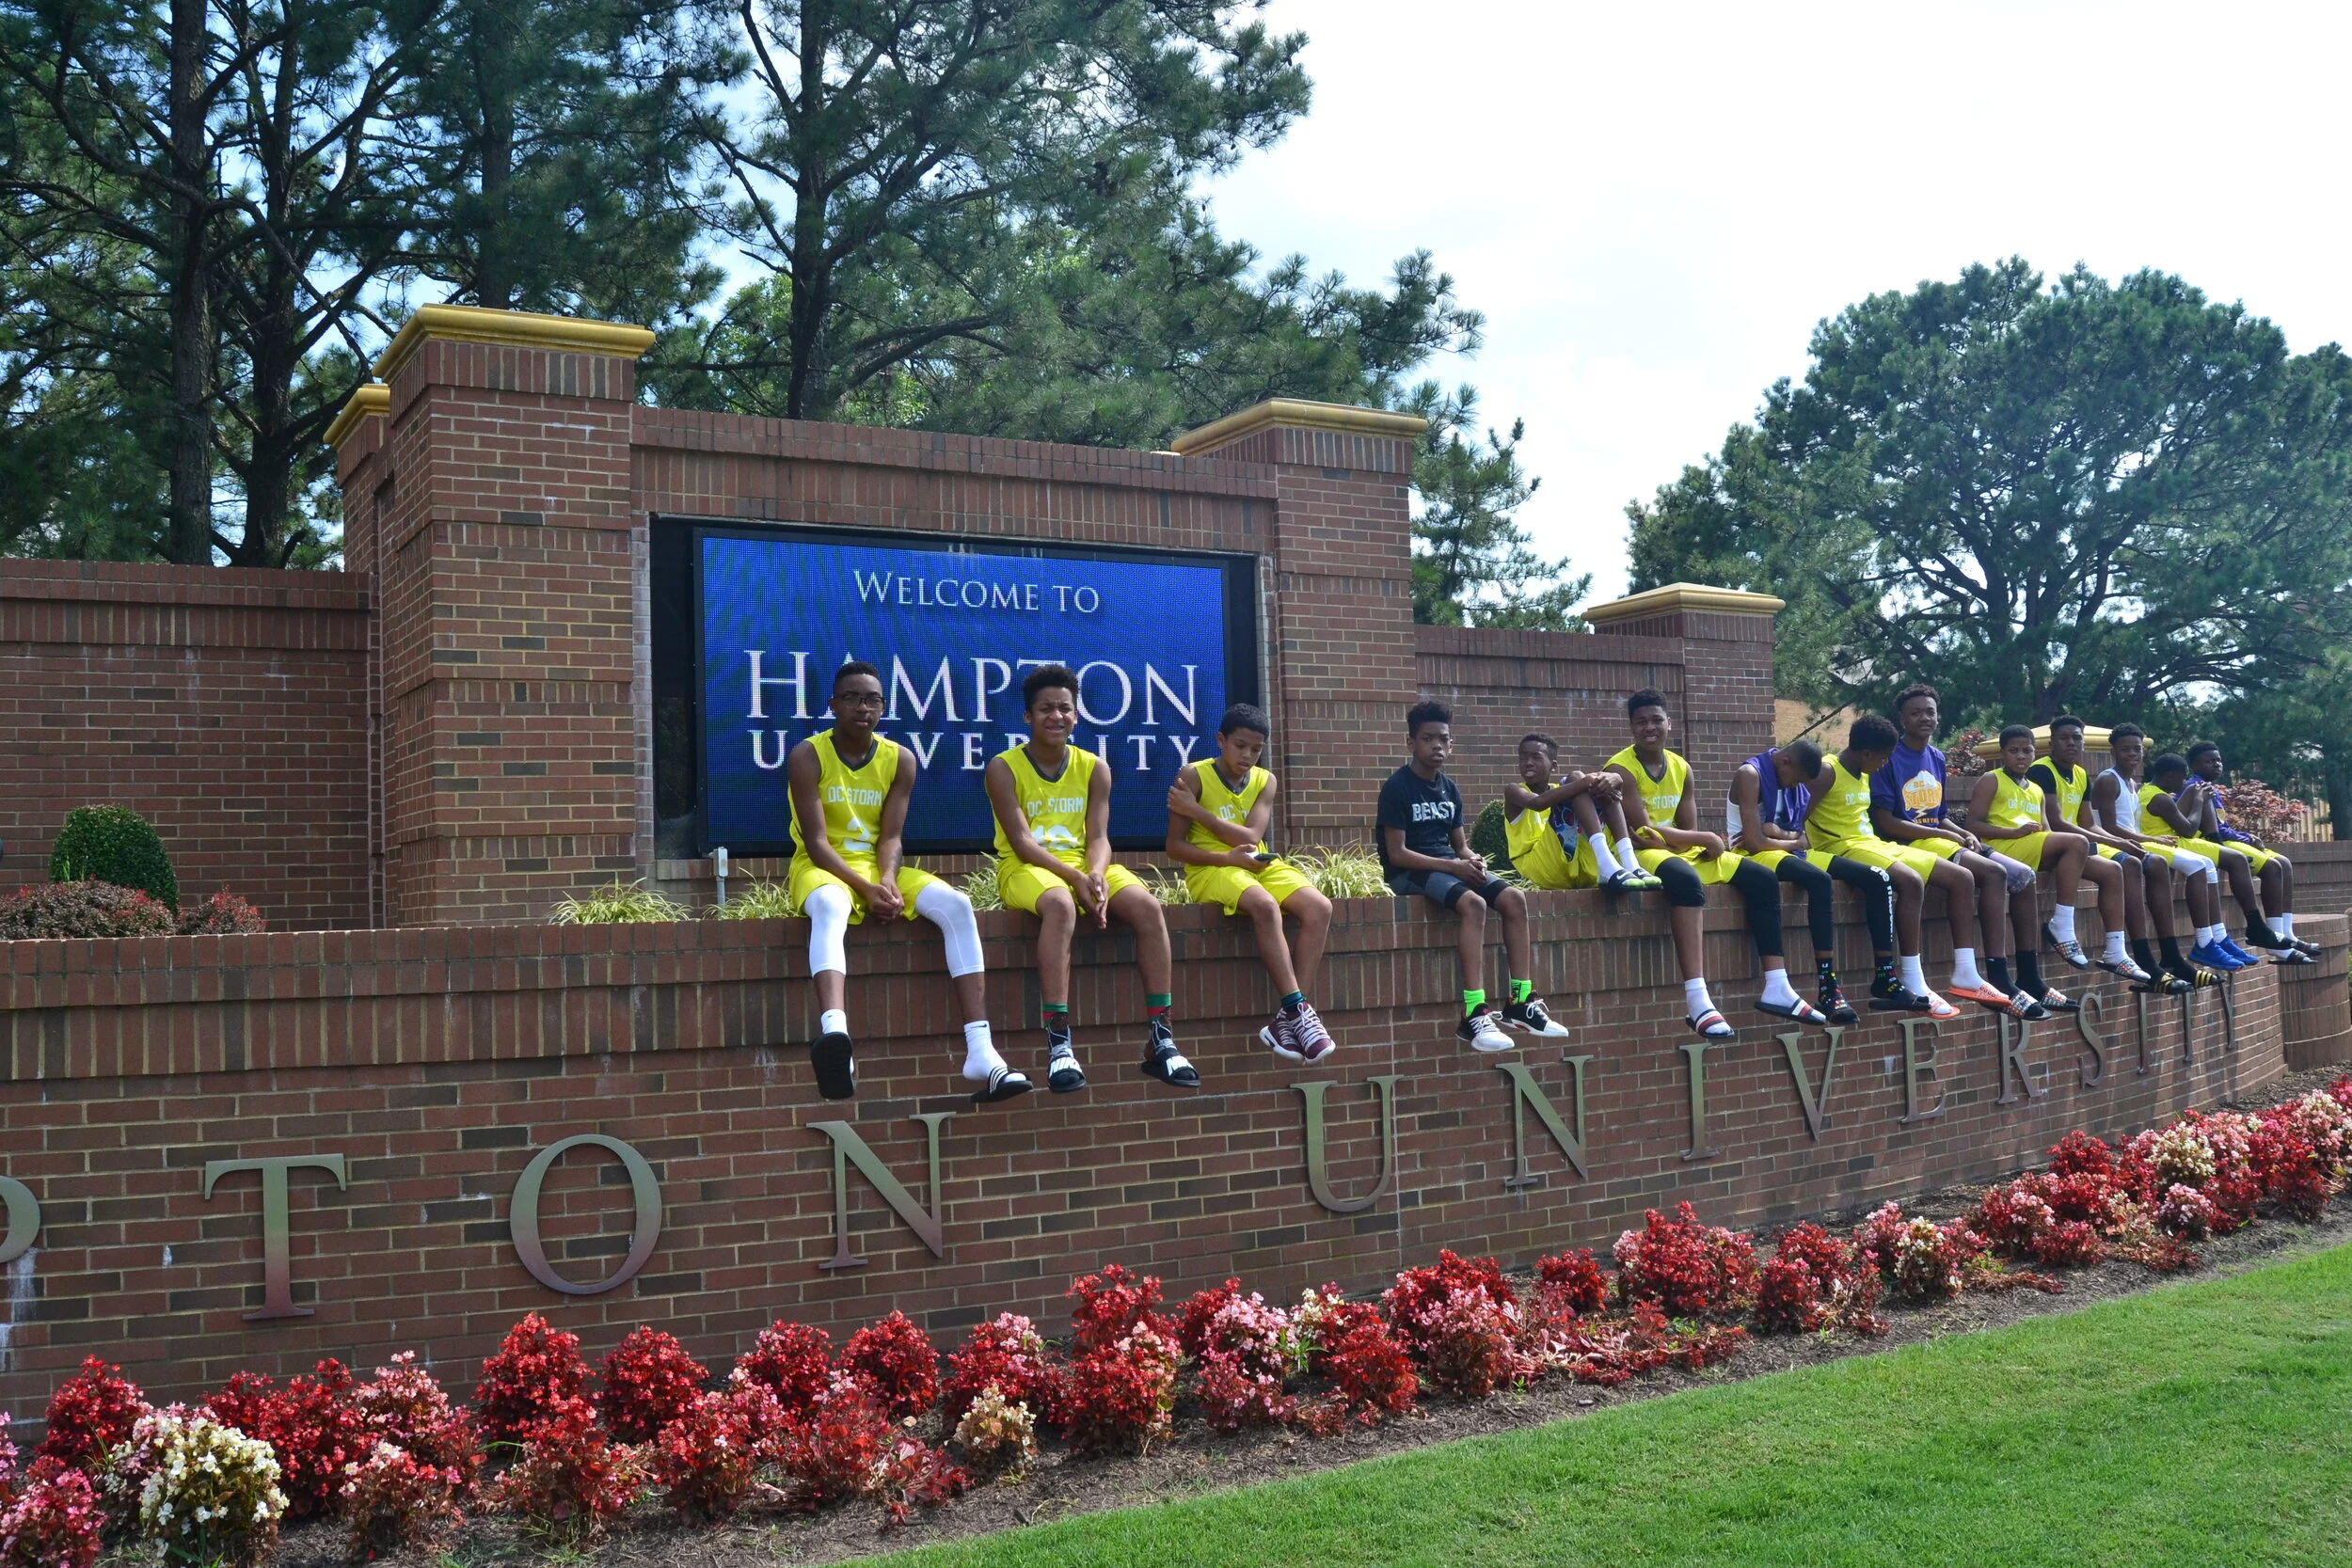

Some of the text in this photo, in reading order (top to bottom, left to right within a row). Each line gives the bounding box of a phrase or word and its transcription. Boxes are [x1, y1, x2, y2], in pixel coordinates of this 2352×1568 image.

[853, 569, 1100, 614] WELCOME TO
[743, 649, 1199, 728] HMPON
[828, 785, 882, 806] DC STORM
[1026, 797, 1084, 817] DC STORM
[1411, 800, 1456, 822] BEAST
